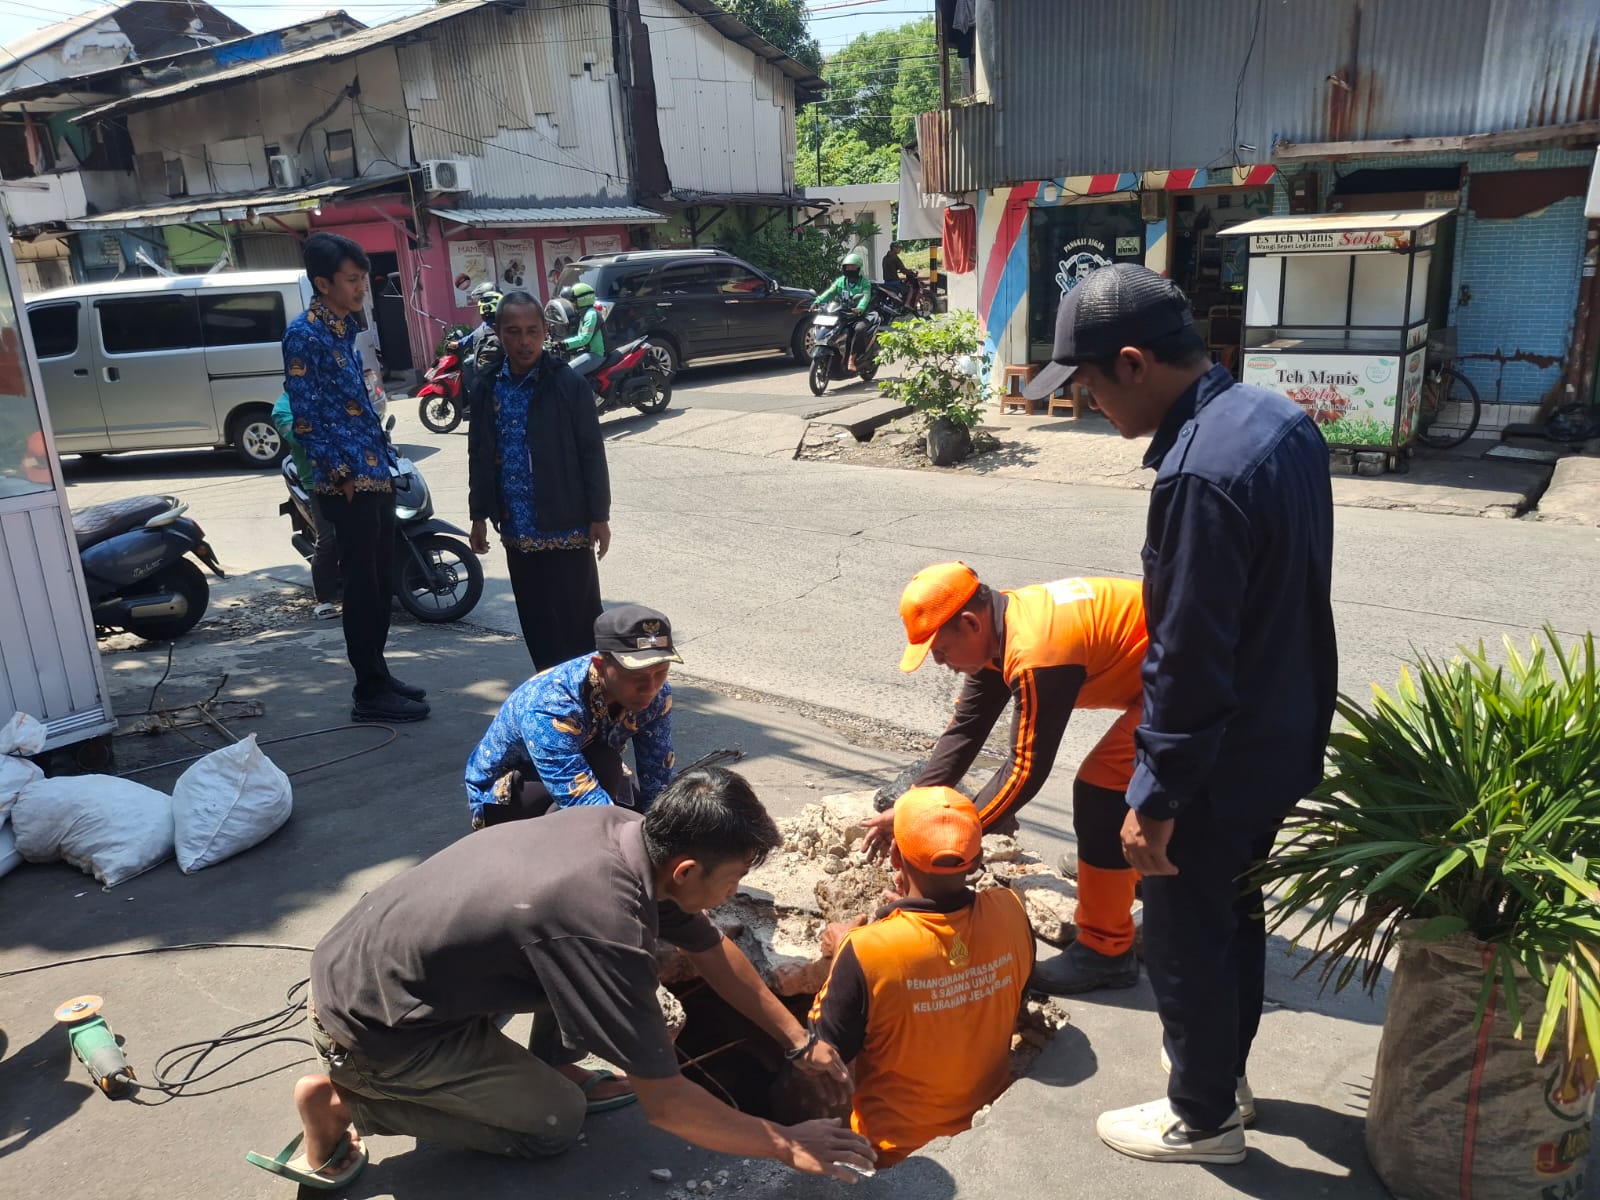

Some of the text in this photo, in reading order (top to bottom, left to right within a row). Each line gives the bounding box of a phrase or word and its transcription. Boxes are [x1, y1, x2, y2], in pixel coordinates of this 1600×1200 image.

[1297, 232, 1334, 243] Manis
[1339, 231, 1382, 246] Solo
[1275, 369, 1303, 384] Teh
[1310, 370, 1359, 385] Manis
[1295, 386, 1337, 401] Solo
[913, 996, 966, 1013] KELURAHAN
